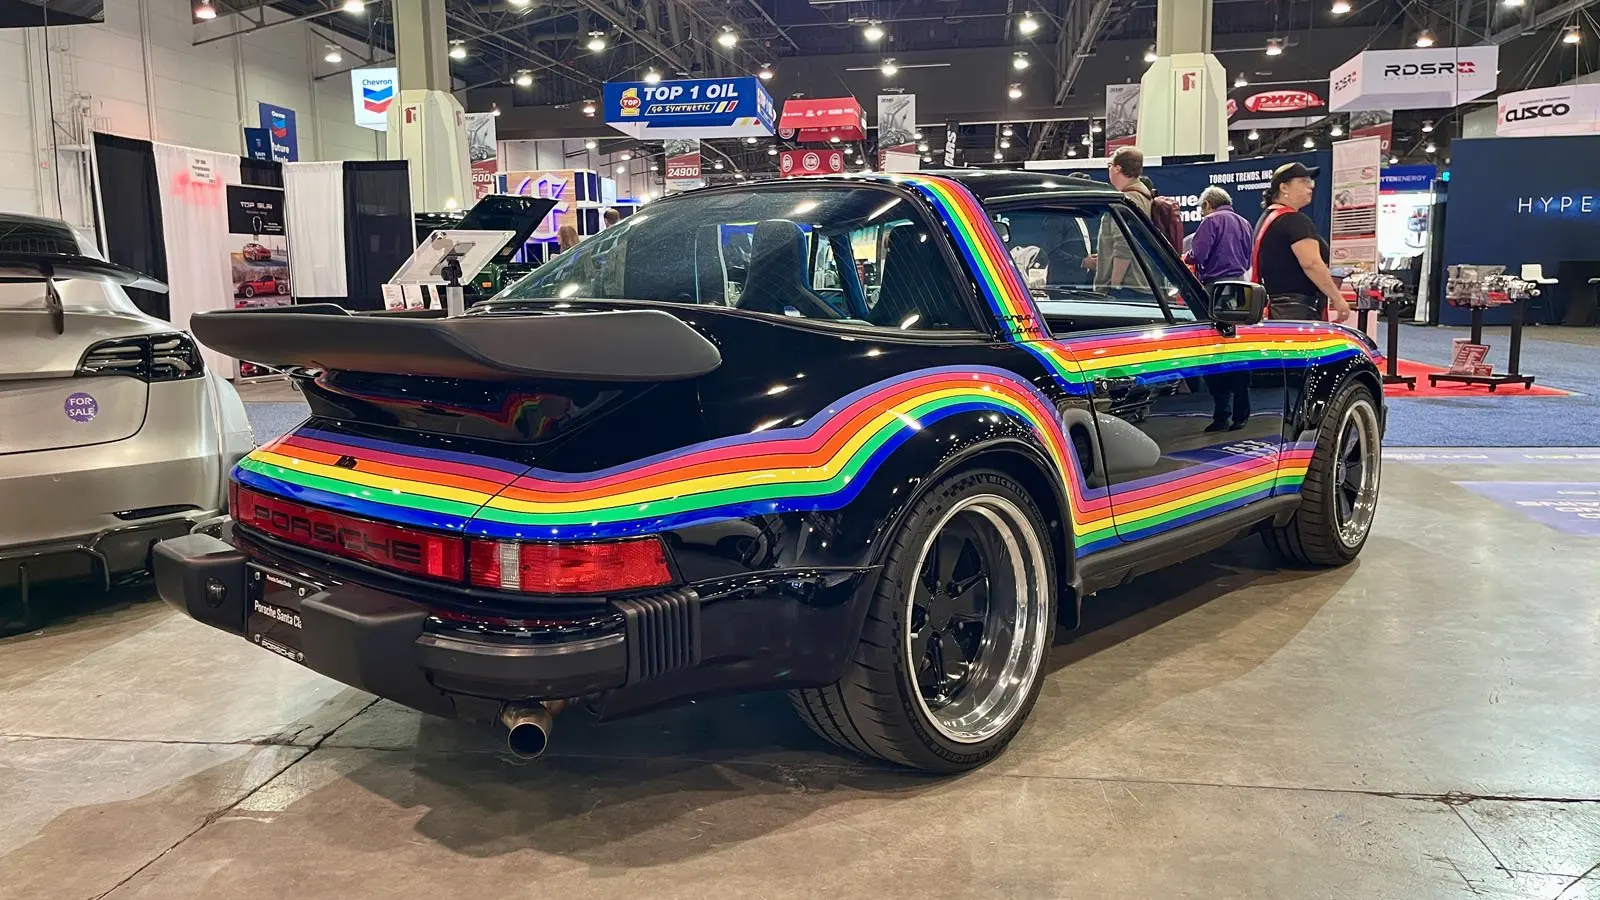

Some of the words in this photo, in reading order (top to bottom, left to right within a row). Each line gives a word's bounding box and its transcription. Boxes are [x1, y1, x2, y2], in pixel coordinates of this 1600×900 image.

[1385, 63, 1455, 76] RDSR
[644, 87, 684, 101] TOP
[690, 86, 699, 99] 1
[706, 84, 739, 98] OIL
[665, 104, 710, 112] SYNTHETIC
[1505, 103, 1571, 122] CUSCO
[667, 168, 699, 177] 24900
[1209, 174, 1235, 184] TORQUE
[1518, 196, 1593, 213] HYPE
[70, 397, 93, 406] FOR
[69, 407, 94, 417] SALE
[988, 475, 1030, 504] MICHELIN
[254, 504, 422, 564] PORSCHE
[255, 599, 277, 619] Porsche
[276, 608, 293, 625] Santa
[261, 640, 296, 660] PORSCHE
